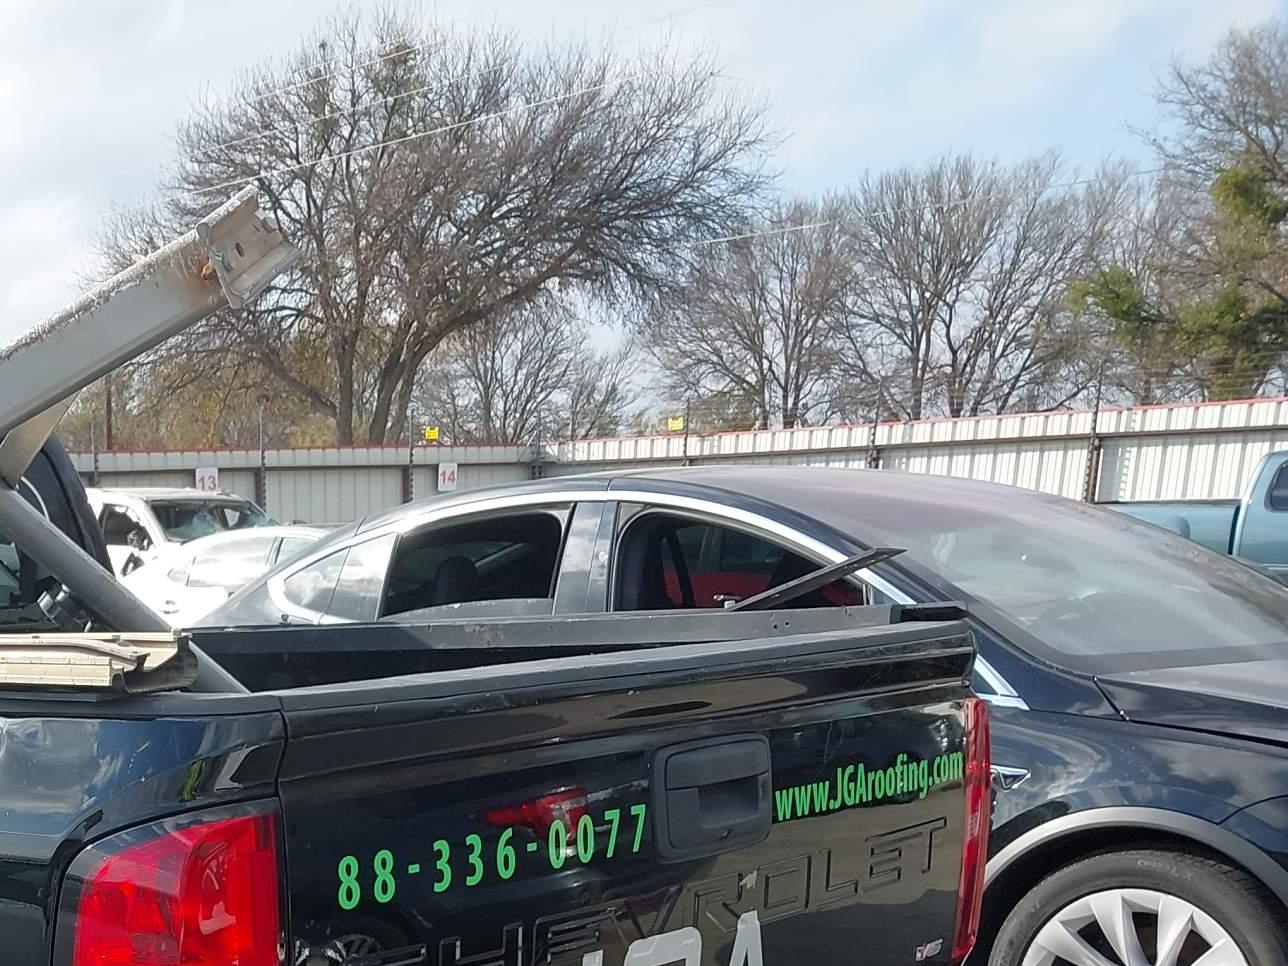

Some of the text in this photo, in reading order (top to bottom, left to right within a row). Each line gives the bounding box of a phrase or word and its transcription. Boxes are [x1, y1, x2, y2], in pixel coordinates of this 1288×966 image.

[198, 475, 217, 491] 13
[440, 469, 456, 485] 14
[775, 751, 963, 821] www.JGAroofing.com
[338, 803, 647, 910] 88-336-0077
